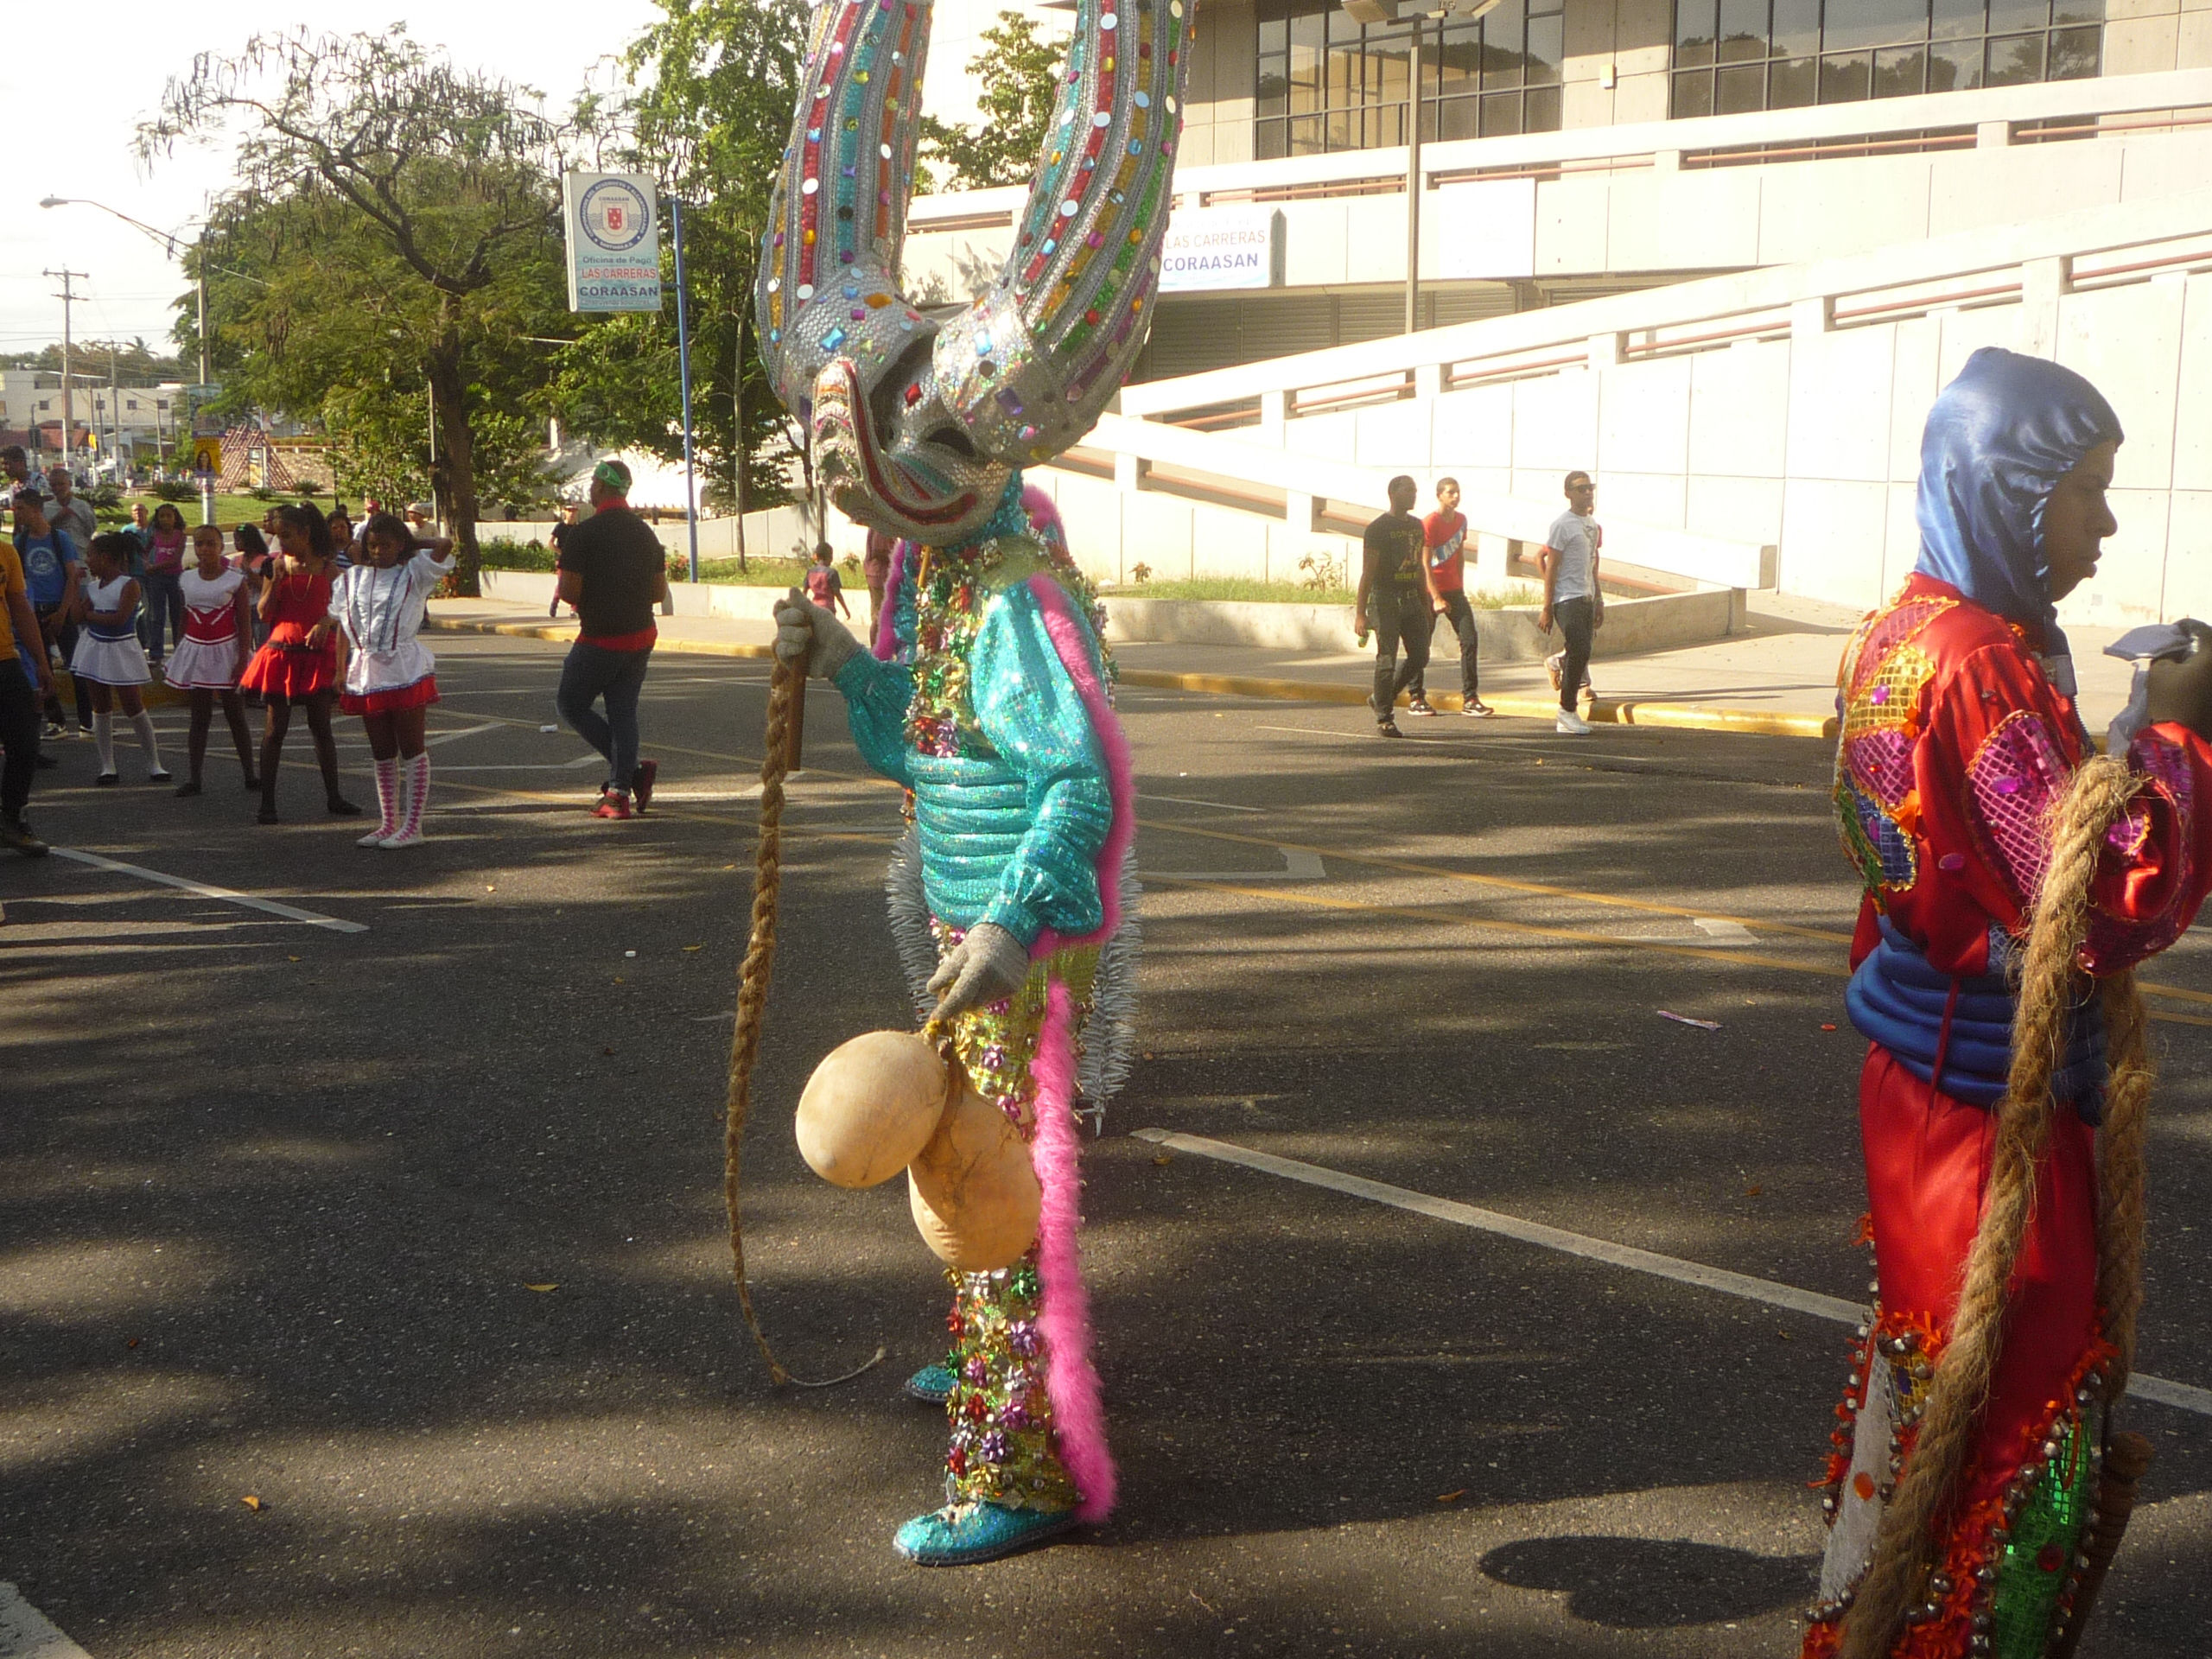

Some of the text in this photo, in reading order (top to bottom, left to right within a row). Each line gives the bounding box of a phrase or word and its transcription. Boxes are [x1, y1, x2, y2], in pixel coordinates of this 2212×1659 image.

[1166, 230, 1266, 249] LAS CARRERAS
[629, 256, 652, 265] Pago
[1163, 252, 1258, 271] CORAASAN
[582, 268, 657, 279] LAS CARRERAS
[580, 286, 658, 296] CORAASAN
